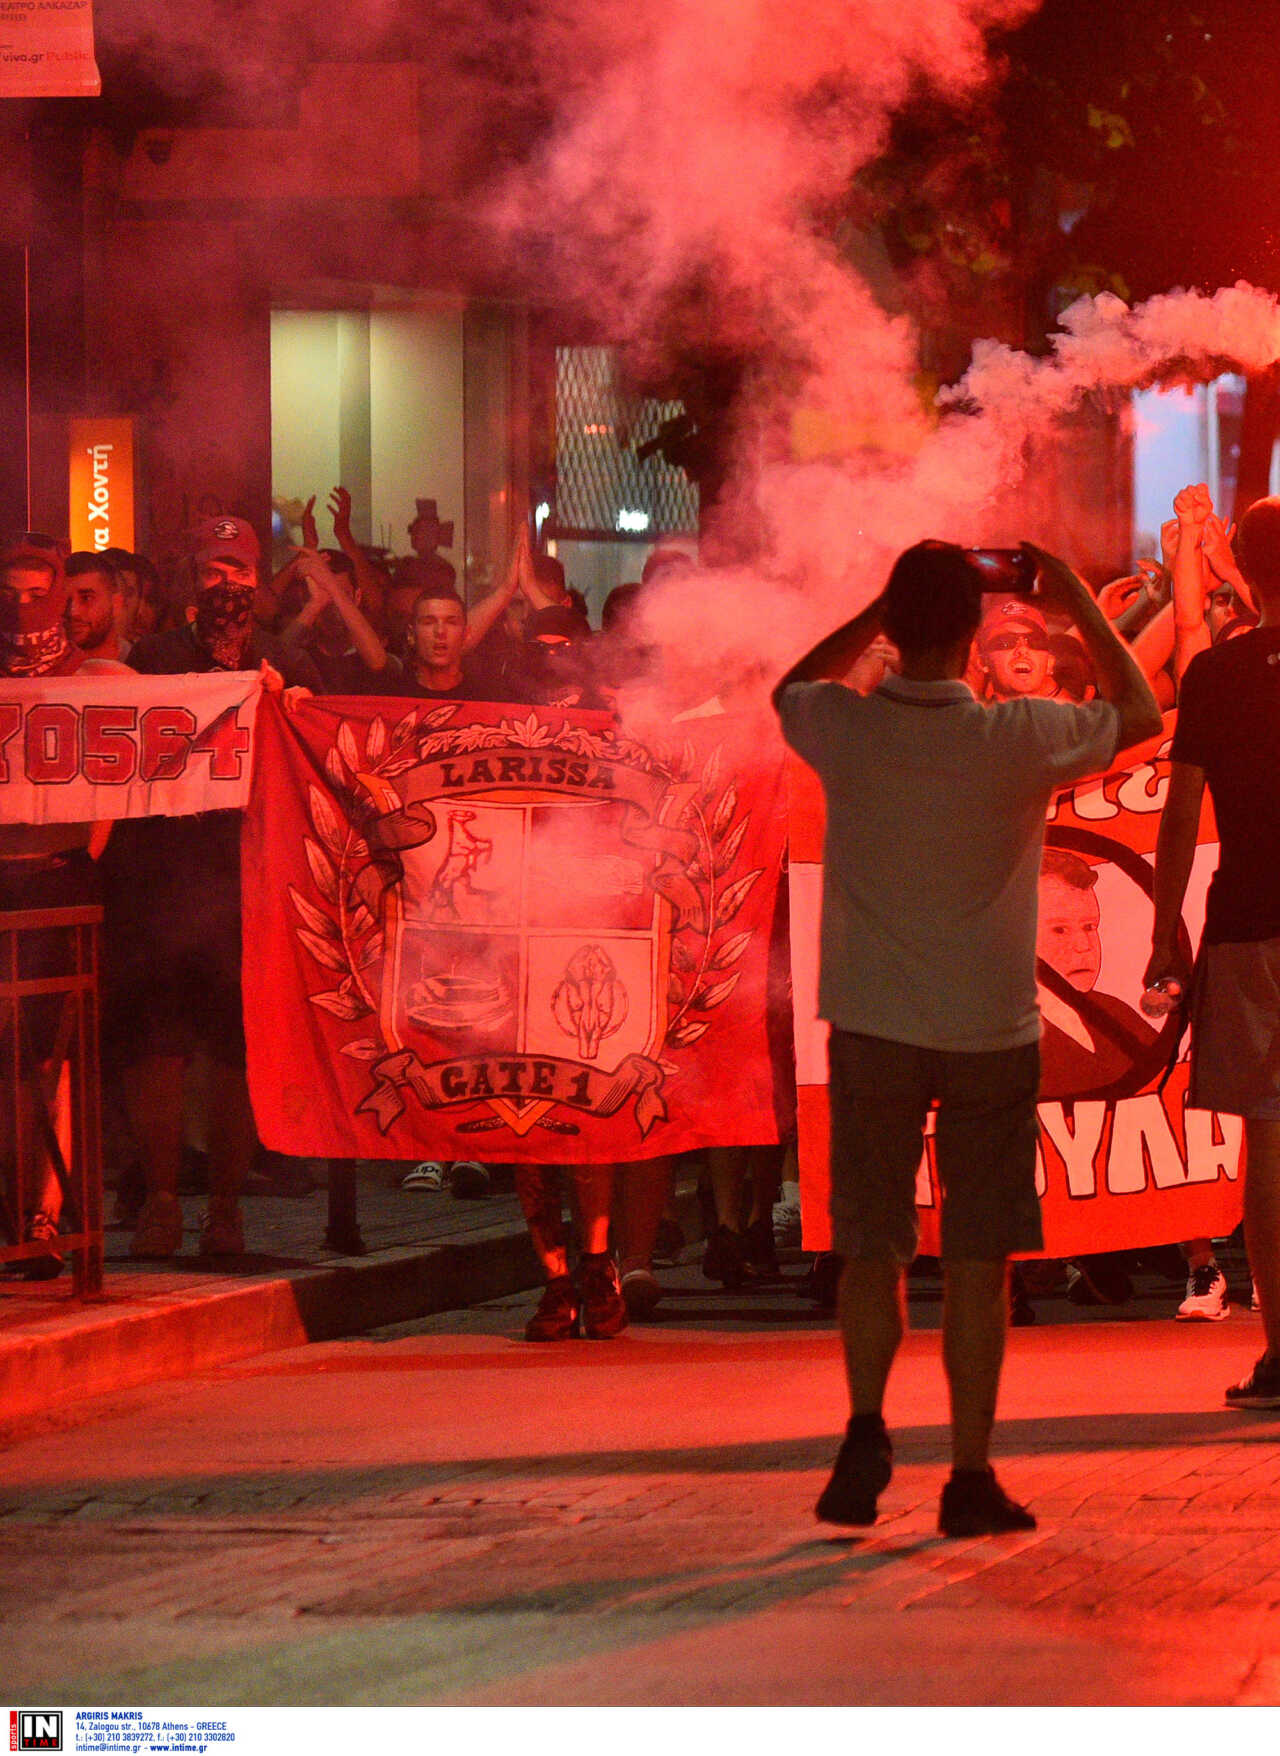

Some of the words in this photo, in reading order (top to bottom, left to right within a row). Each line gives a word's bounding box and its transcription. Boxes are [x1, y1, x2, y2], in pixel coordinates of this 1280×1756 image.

[87, 444, 114, 521] Χοντή
[439, 755, 617, 790] LARISSA
[440, 1061, 556, 1099] GATE
[566, 1070, 594, 1107] 1
